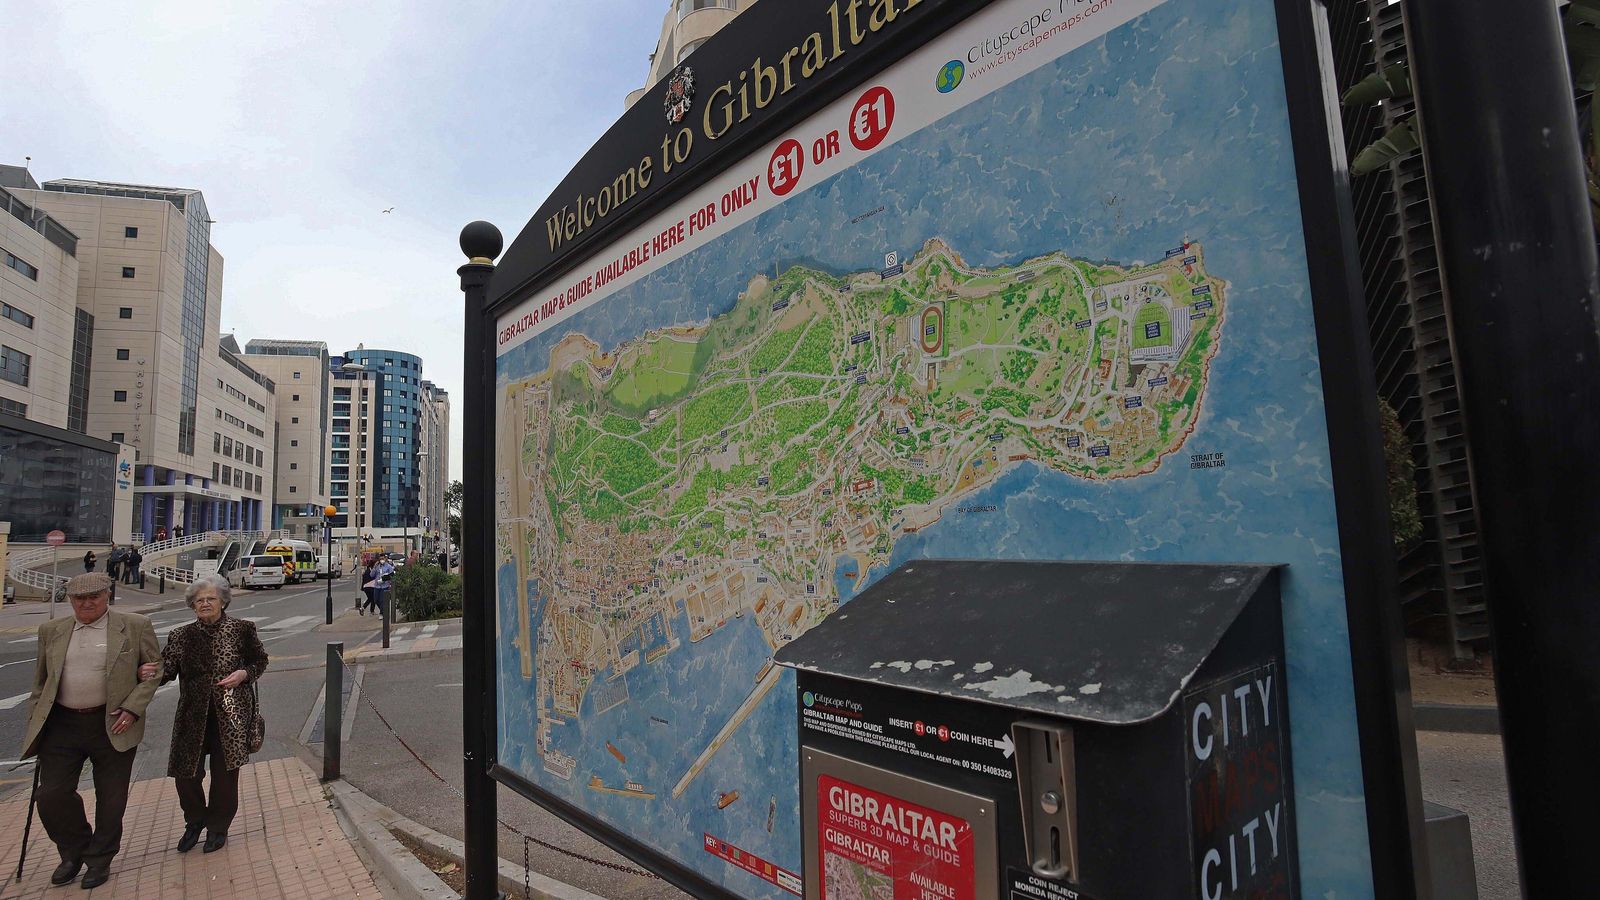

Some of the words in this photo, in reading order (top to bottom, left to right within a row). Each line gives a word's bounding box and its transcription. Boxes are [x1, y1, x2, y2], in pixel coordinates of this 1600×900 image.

[967, 8, 1052, 64] Cityscape
[545, 156, 652, 252] Welcome
[661, 128, 692, 173] to
[703, 0, 924, 140] Gibralta
[499, 309, 539, 346] GIBRALTAR
[541, 300, 557, 322] MAP
[558, 294, 566, 310] &
[566, 275, 592, 306] GUIDE
[594, 240, 650, 290] AVAILABLE
[652, 220, 685, 257] HERE
[689, 202, 716, 236] FOR
[721, 175, 760, 217] ONLY
[771, 146, 798, 190] £1
[812, 130, 840, 166] OR
[853, 93, 887, 142] €1
[132, 369, 144, 444] HOSPITA
[1190, 454, 1214, 462] STRAIT
[1215, 452, 1224, 460] OF
[1190, 460, 1226, 470] GIBRALTAR
[803, 708, 834, 722] GIBRALTAR
[835, 716, 848, 724] MAP
[849, 720, 862, 728] AND
[863, 722, 882, 734] GUIDE
[846, 700, 862, 712] Maps
[1192, 676, 1272, 761] CITY
[872, 734, 894, 744] CITYSCAPE
[888, 718, 914, 730] INSERT
[926, 726, 936, 735] OR
[950, 730, 970, 742] COIN
[971, 735, 994, 748] HERE
[882, 742, 898, 750] PLEASE
[899, 746, 909, 754] CALL
[920, 752, 935, 760] LOCAL
[936, 755, 952, 764] AGENT
[962, 760, 969, 768] 00
[970, 762, 982, 772] 350
[982, 765, 1012, 779] 54083329
[1195, 741, 1280, 834] MAPS
[829, 786, 958, 852] GIBRALTAR
[706, 836, 717, 848] KEY:
[825, 828, 890, 866] GIBRALTAR
[829, 809, 868, 832] SUPERB
[870, 825, 883, 838] 3D
[886, 830, 910, 846] MAP
[912, 840, 920, 853] &
[923, 843, 960, 868] GUIDE
[1201, 802, 1281, 900] CITY
[910, 872, 956, 900] AVAILABLE
[1014, 880, 1046, 898] MONEDA
[1028, 876, 1047, 889] COIN
[1048, 882, 1079, 900] REJECT
